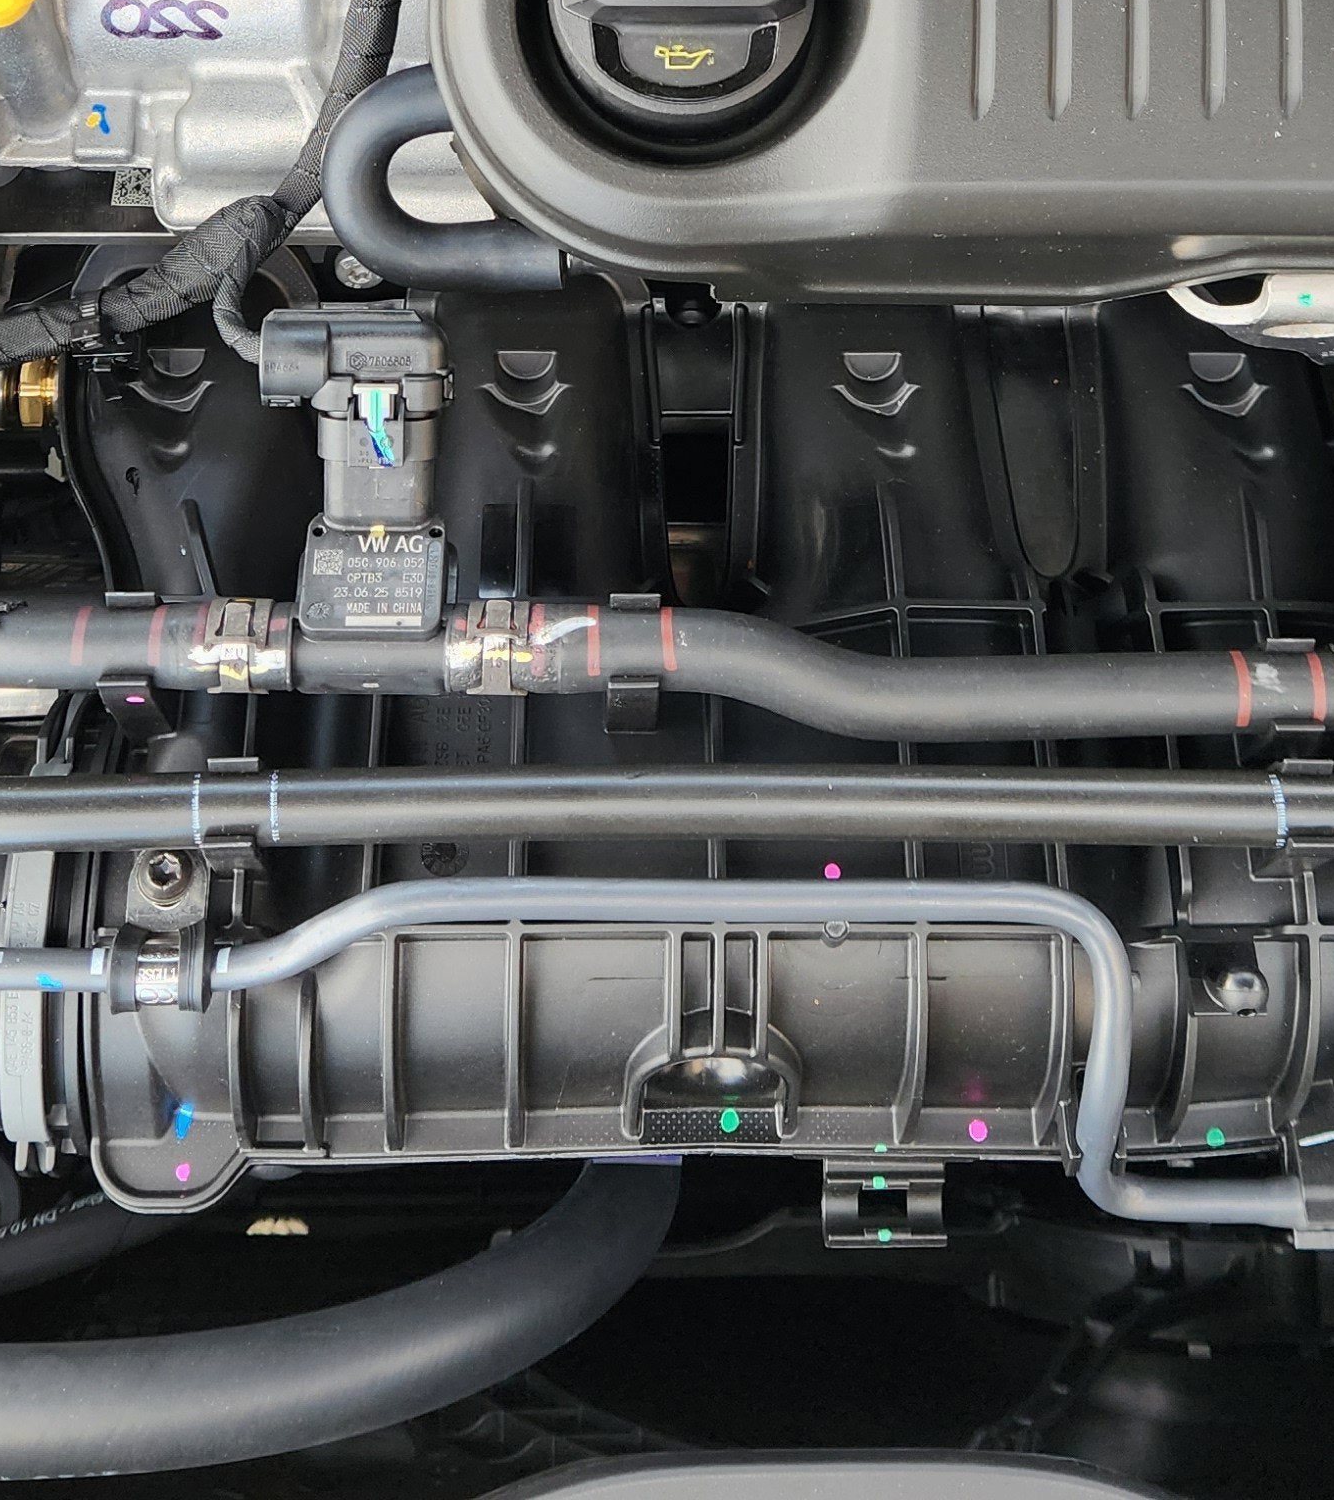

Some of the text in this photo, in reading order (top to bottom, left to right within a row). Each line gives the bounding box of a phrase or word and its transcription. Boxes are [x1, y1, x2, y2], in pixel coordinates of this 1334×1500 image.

[358, 535, 424, 554] VW AG
[334, 587, 423, 598] 23.06.25 8519
[346, 602, 423, 614] MADE IN CHINA
